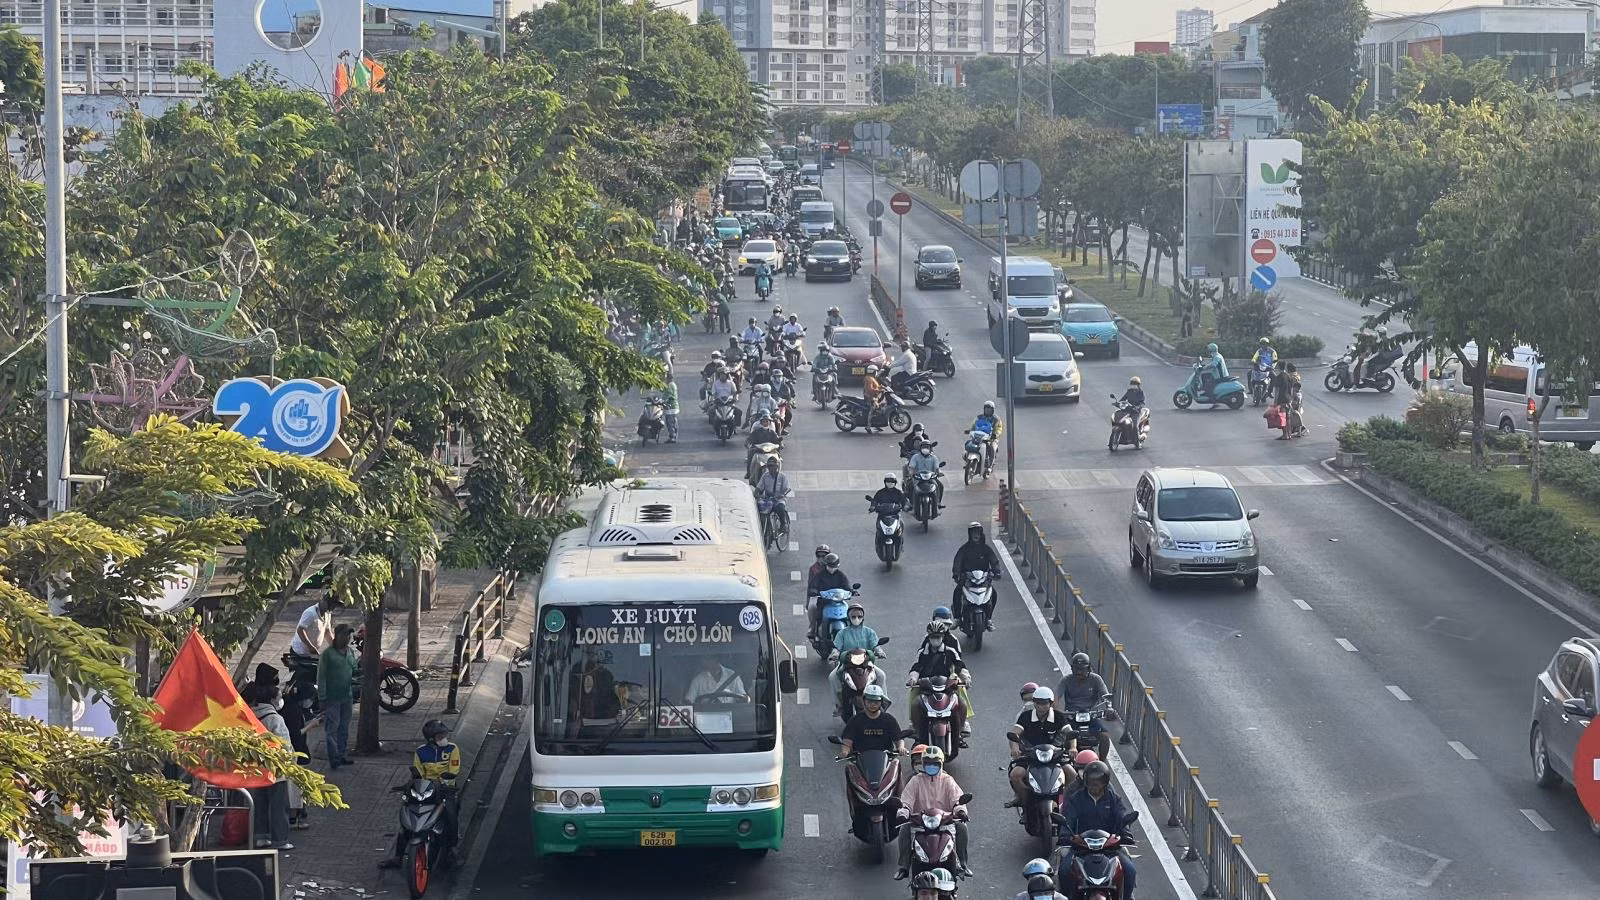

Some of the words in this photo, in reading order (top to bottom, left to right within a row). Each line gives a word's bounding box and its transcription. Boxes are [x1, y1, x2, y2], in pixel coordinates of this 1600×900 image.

[611, 608, 638, 624] XE
[645, 605, 697, 624] BUÝT
[742, 610, 760, 625] 628
[575, 627, 619, 645] LONG
[622, 627, 645, 644] AN
[663, 623, 698, 646] CHỢ
[701, 621, 732, 643] LỚN
